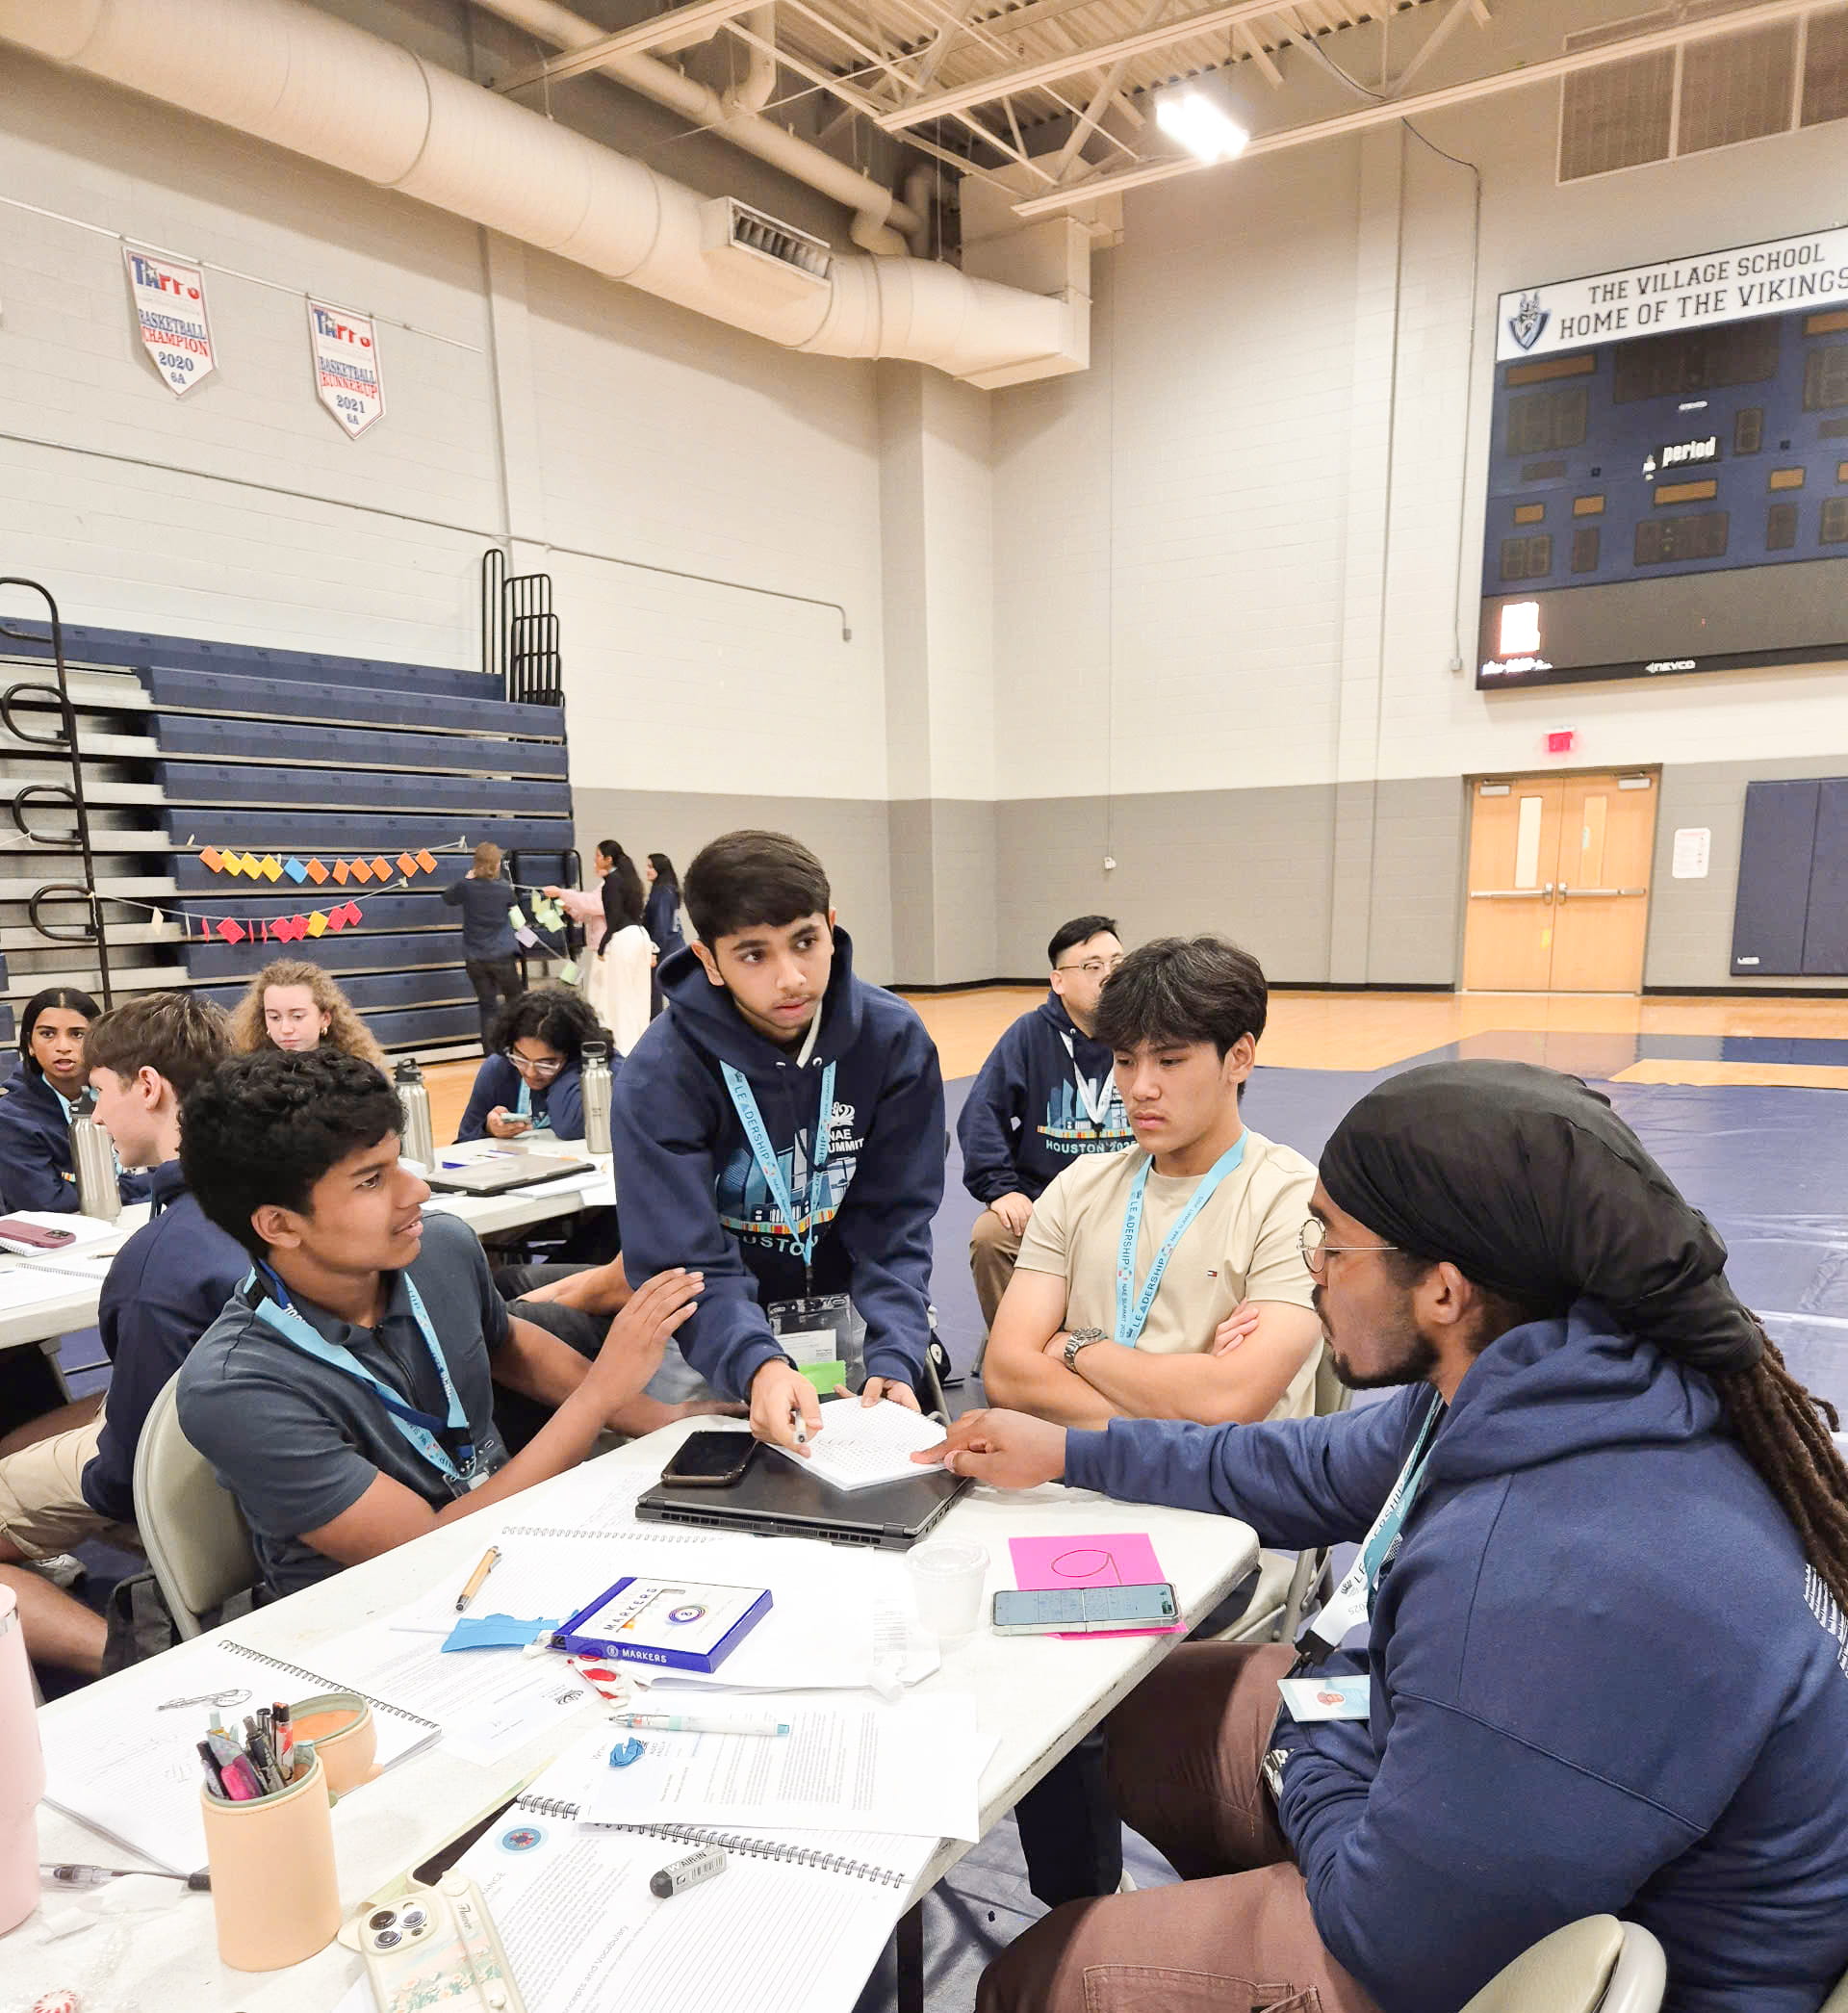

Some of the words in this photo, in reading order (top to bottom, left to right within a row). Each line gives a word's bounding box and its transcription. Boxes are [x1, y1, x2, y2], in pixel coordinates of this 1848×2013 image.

[1589, 280, 1629, 304] THE
[1637, 261, 1731, 296] VILLAGE
[1737, 244, 1826, 277] SCHOOL
[1559, 307, 1630, 340] HOME
[1637, 300, 1668, 324] OF
[1678, 289, 1728, 318] THE
[1738, 267, 1848, 307] VIKINGS
[158, 350, 193, 372] 2020
[336, 395, 365, 413] 2021
[1662, 436, 1716, 468] period
[829, 1137, 864, 1153] UMMIT
[1045, 1139, 1105, 1154] HOUSTON
[1122, 1200, 1139, 1266] LEADERSHIP
[1132, 1257, 1166, 1329] LEADERSHIP
[603, 1587, 658, 1631] MARKERS
[622, 1647, 667, 1664] MARKERS
[595, 1925, 629, 1966] Vocabulary
